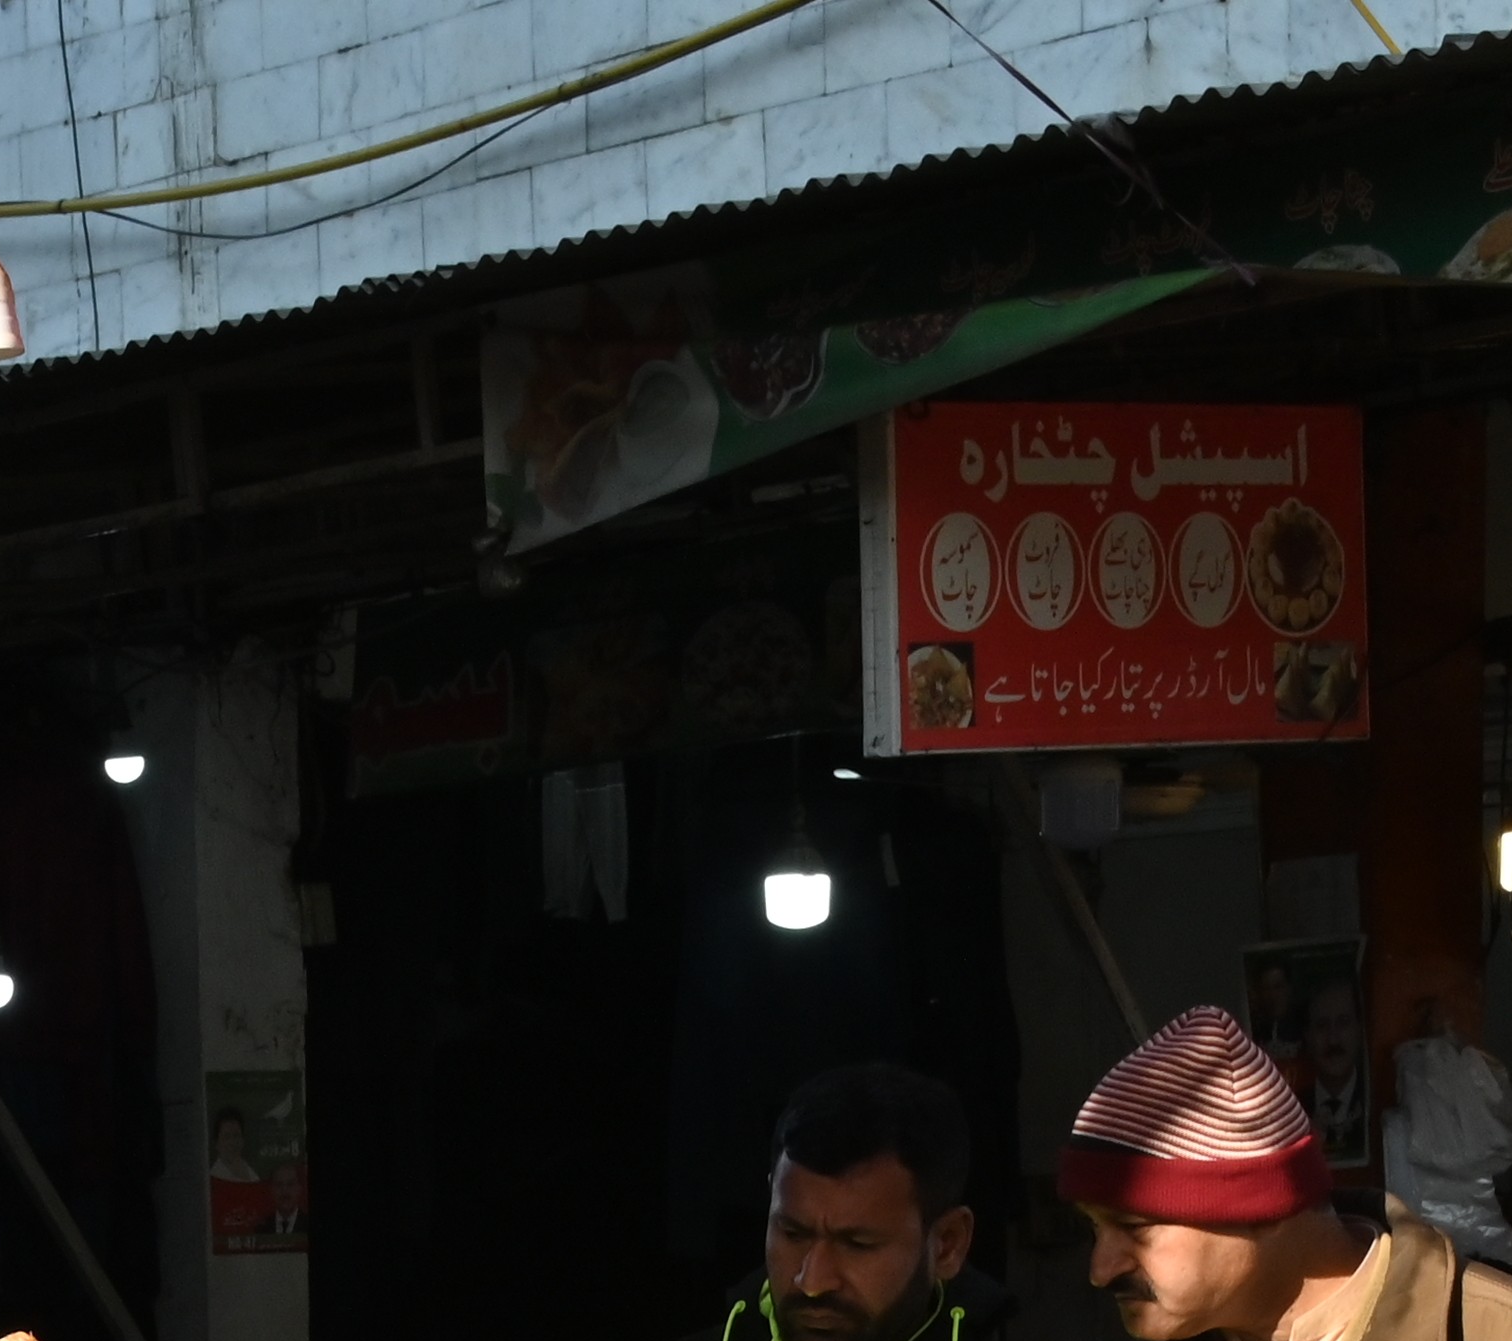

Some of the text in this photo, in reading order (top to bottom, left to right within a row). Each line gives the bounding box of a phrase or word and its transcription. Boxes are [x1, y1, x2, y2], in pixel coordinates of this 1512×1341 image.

[959, 415, 1307, 513] اسپیشل چٹخارہ
[942, 569, 977, 618] چاٹ
[1028, 569, 1063, 618] چاٹ
[983, 669, 1025, 724] ہے
[1078, 646, 1114, 715] کیا
[1105, 659, 1145, 714] تیار
[1144, 670, 1164, 719] پر
[1168, 648, 1226, 699] آرڈر
[1227, 645, 1267, 705] مال
